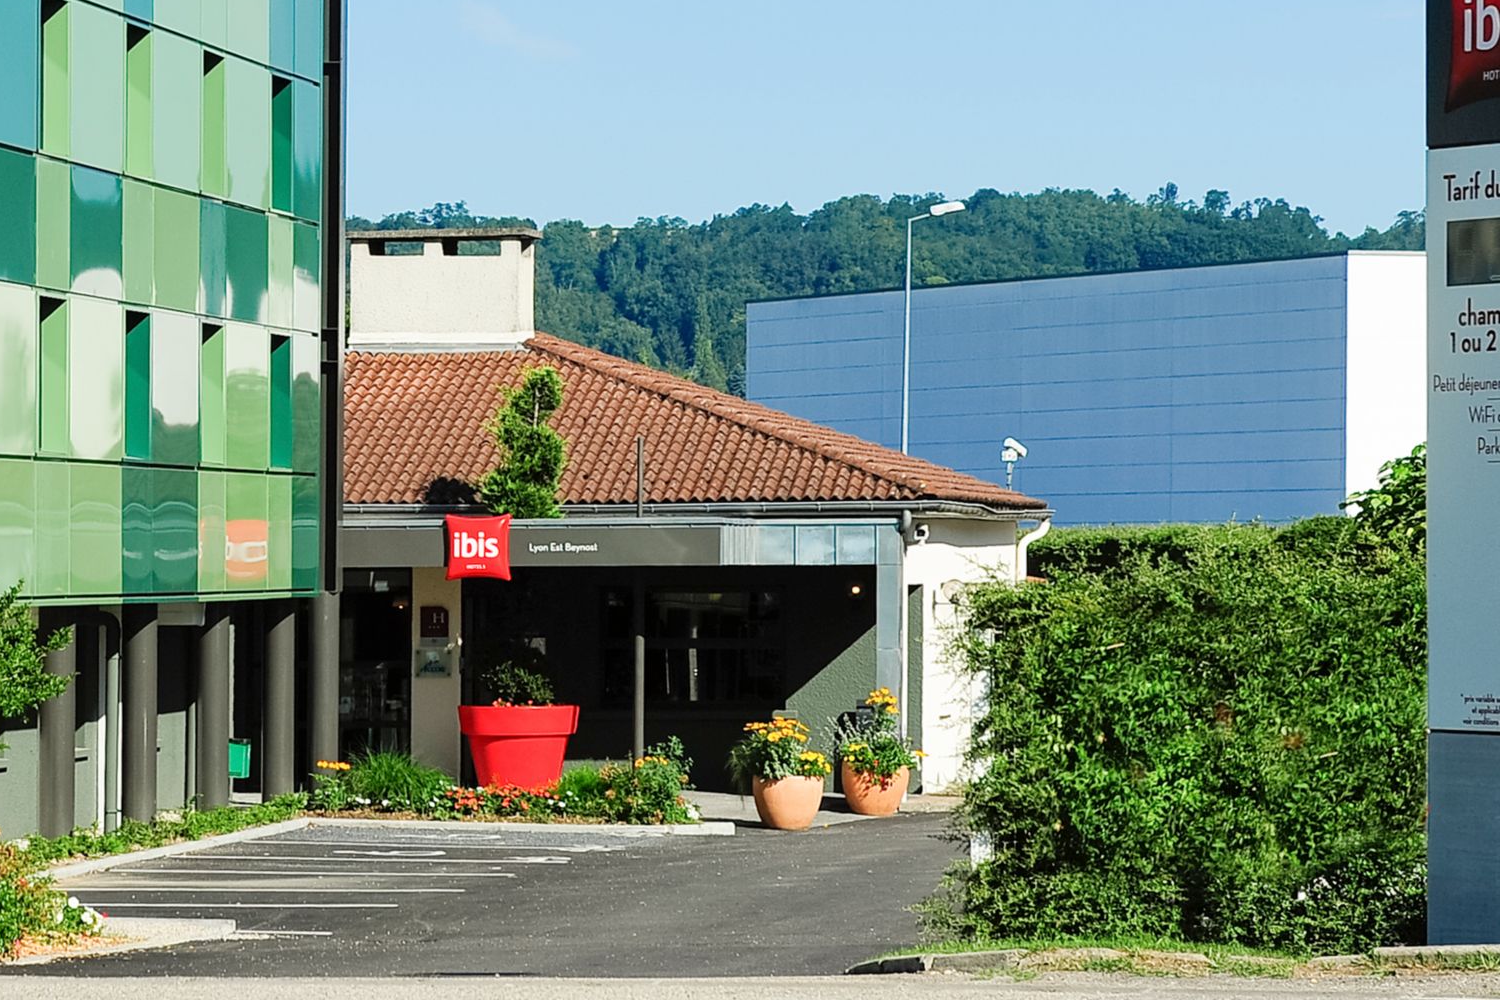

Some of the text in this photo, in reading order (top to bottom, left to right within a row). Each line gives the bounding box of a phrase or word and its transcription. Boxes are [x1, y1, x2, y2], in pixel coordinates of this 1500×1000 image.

[1443, 170, 1481, 201] Tarif
[1458, 297, 1500, 326] cham
[1450, 329, 1497, 353] 1 ou 2
[1433, 374, 1456, 392] Petit
[1468, 405, 1495, 423] WiFi
[453, 531, 499, 558] ibis
[529, 542, 549, 554] Lyon
[550, 542, 564, 552] Est
[433, 612, 444, 623] H
